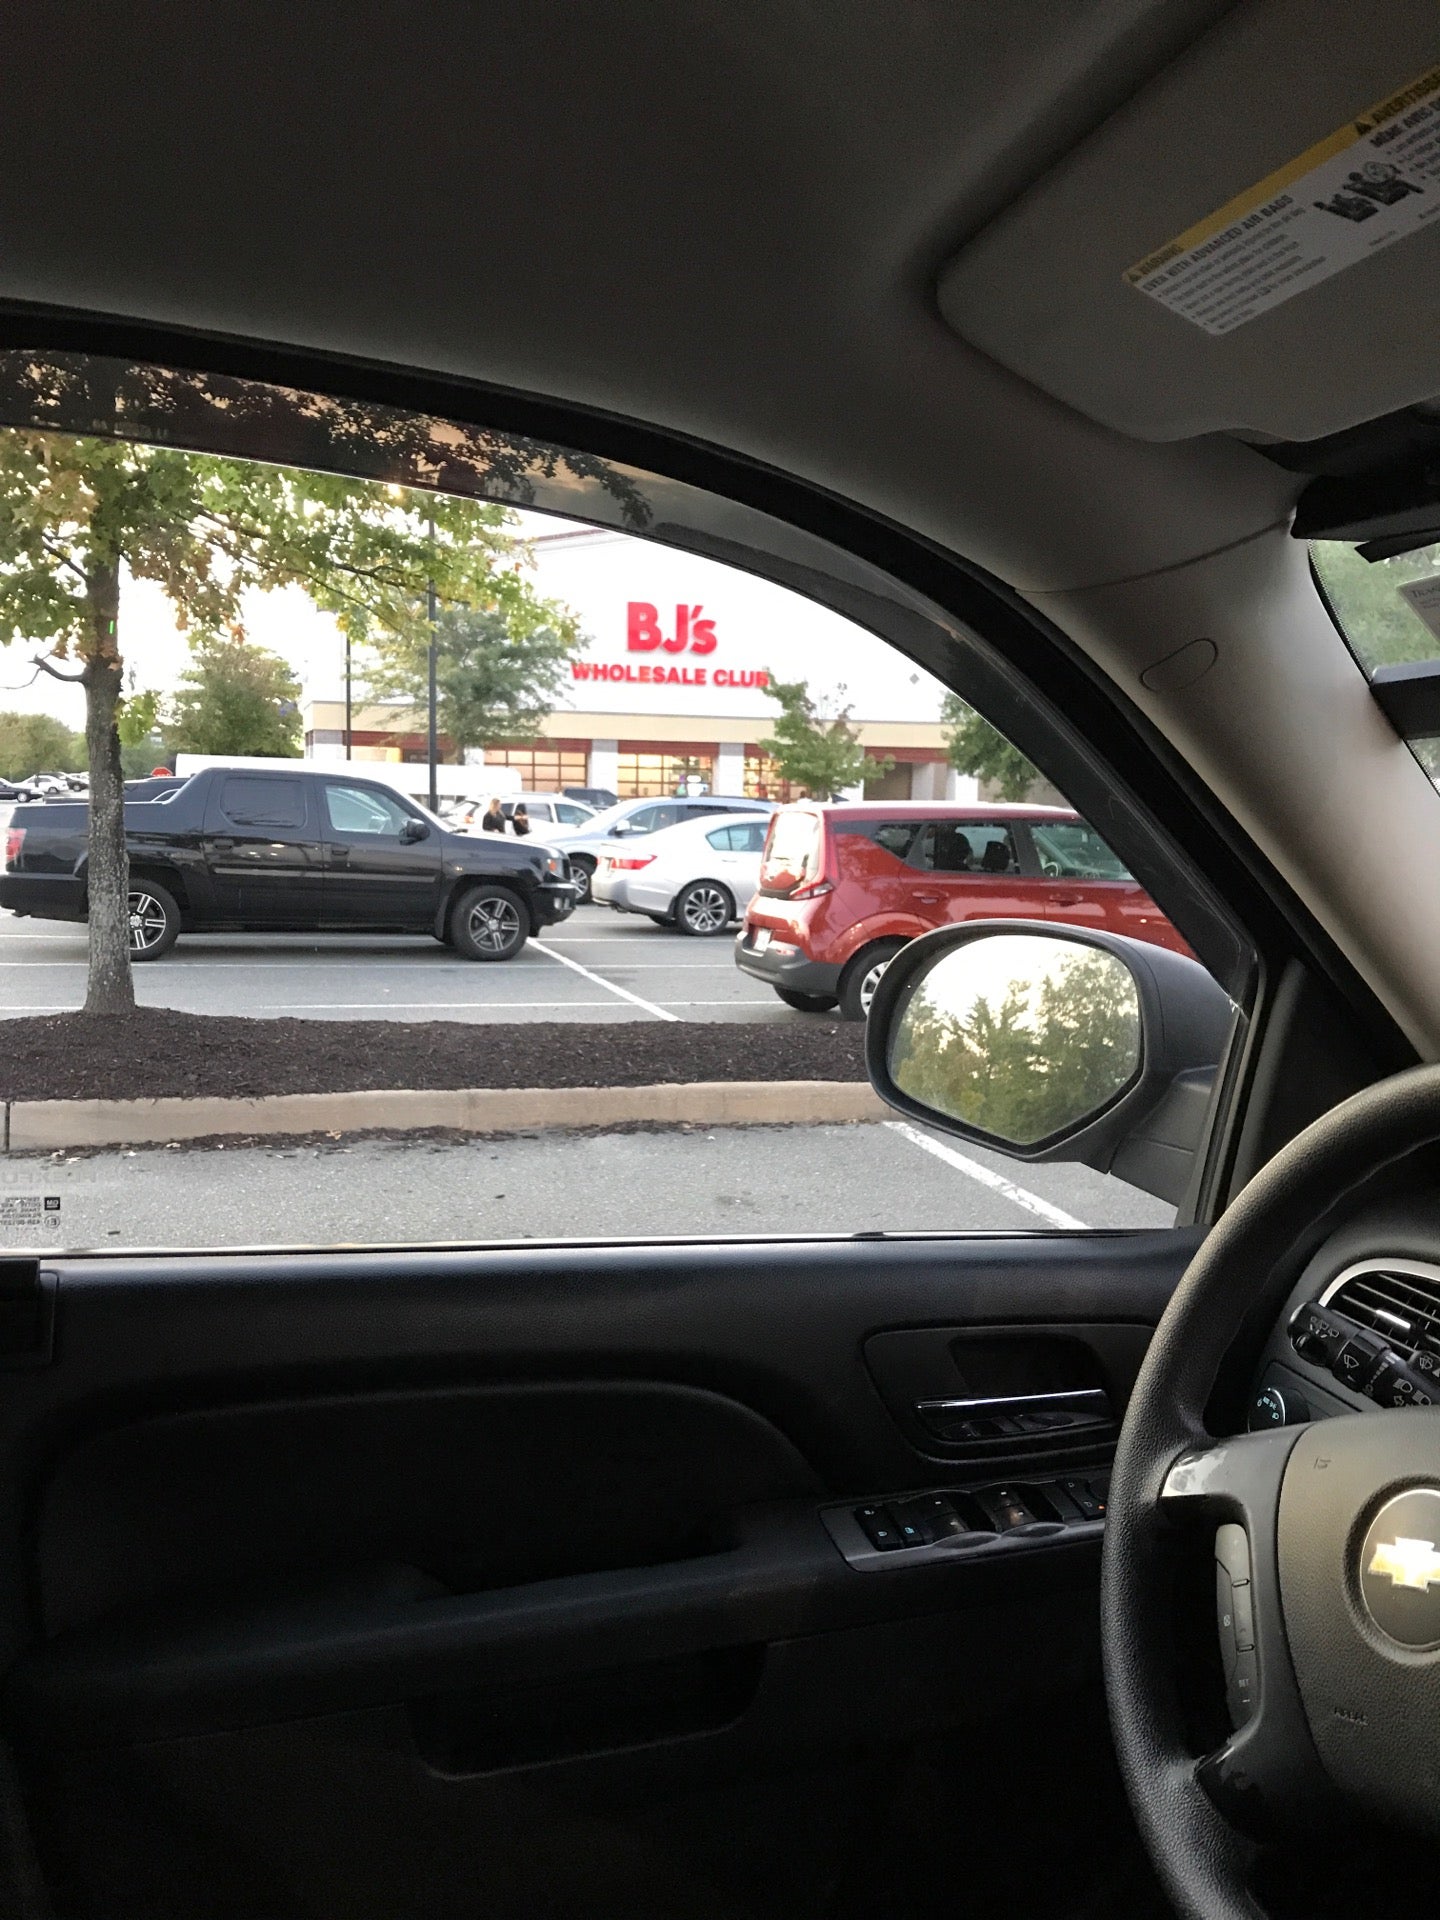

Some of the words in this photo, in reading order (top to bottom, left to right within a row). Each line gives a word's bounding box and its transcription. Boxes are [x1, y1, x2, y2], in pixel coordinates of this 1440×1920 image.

[1190, 226, 1243, 262] ADVANCED
[1241, 214, 1264, 230] AIR
[1260, 194, 1293, 217] BAGS
[627, 601, 718, 655] BJ's
[571, 662, 707, 686] WHOLESALE
[713, 668, 769, 688] CLUB
